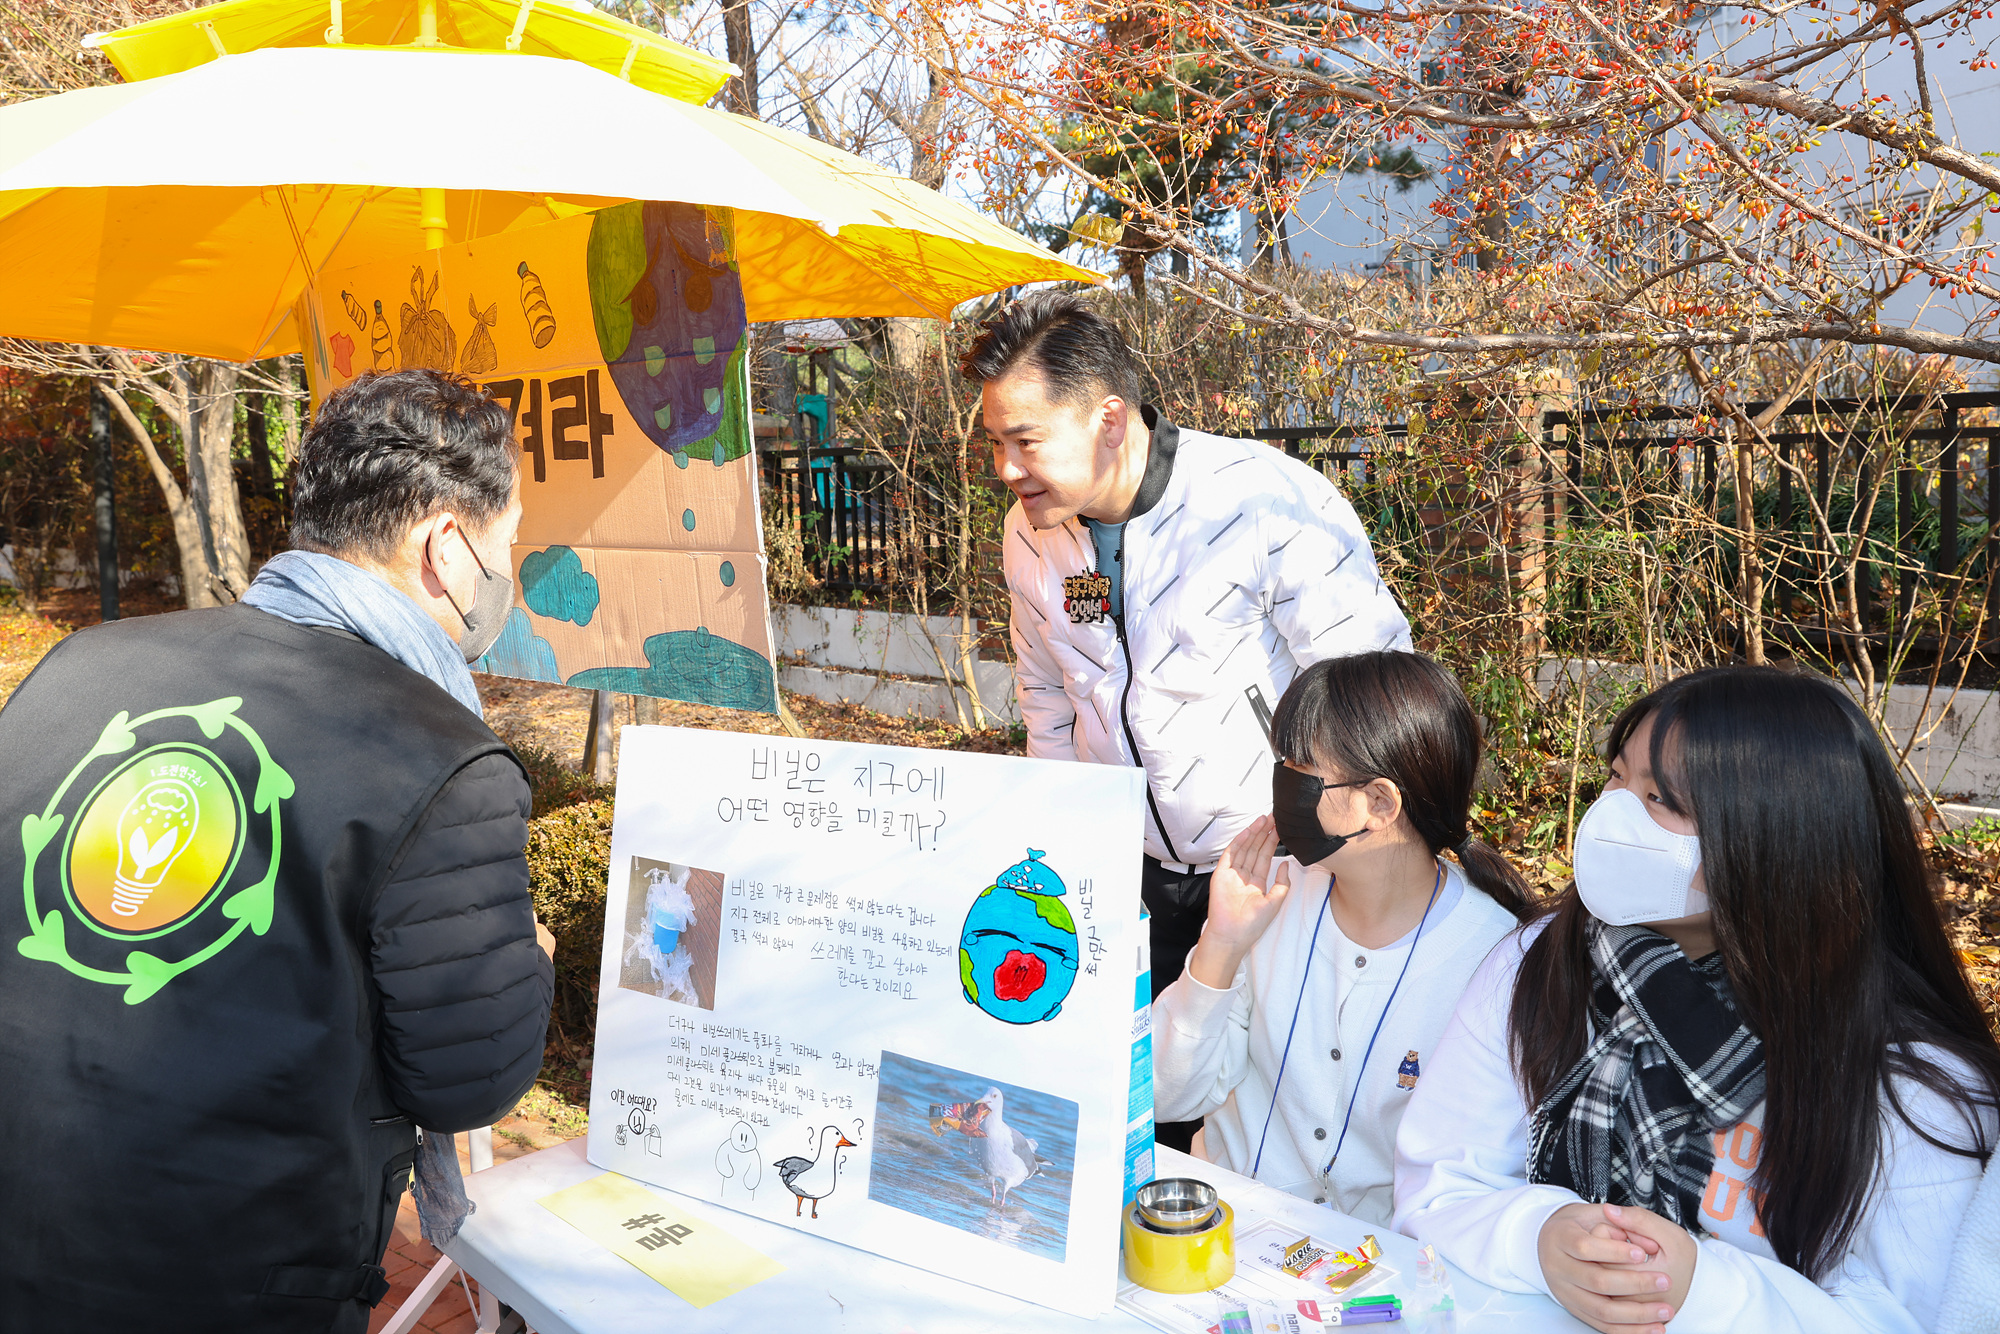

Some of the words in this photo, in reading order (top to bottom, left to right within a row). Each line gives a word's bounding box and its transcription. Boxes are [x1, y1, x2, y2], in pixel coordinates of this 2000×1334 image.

[1064, 576, 1111, 598] 도봉구청장
[1069, 599, 1102, 622] 오언석
[752, 747, 825, 793] 비닐은
[854, 760, 944, 801] 지구에
[718, 797, 769, 822] 어떤
[783, 801, 843, 833] 영향을
[732, 879, 764, 900] 비닐은
[773, 883, 793, 903] 가장
[797, 888, 804, 902] 큰
[807, 890, 839, 909] 문제점은
[846, 896, 864, 912] 썩지
[867, 899, 904, 918] 않는다는
[908, 907, 936, 927] 겁니다
[1079, 879, 1093, 919] 비닐
[731, 906, 748, 923] 지구
[753, 910, 780, 925] 전체로
[787, 915, 834, 930] 어마어마한
[838, 918, 857, 936] 양의
[862, 925, 886, 943] 비닐을
[892, 932, 923, 951] 사용하고
[927, 939, 953, 957] 있는데
[731, 929, 747, 944] 결국
[752, 931, 768, 946] 썩지
[773, 937, 794, 951] 않으니
[810, 941, 856, 964] 쓰레기를
[862, 949, 886, 969] 깔고
[893, 957, 928, 976] 살아야
[837, 967, 869, 989] 한다는
[872, 978, 919, 1000] 것이지요
[669, 1015, 695, 1034] 더구나
[832, 1052, 853, 1071] 열과
[671, 1036, 691, 1054] 의해
[667, 1072, 681, 1084] 다시
[720, 1062, 742, 1080] 육지나
[748, 1073, 763, 1086] 바다
[611, 1089, 625, 1106] 이건
[1286, 1313, 1300, 1334] nam
